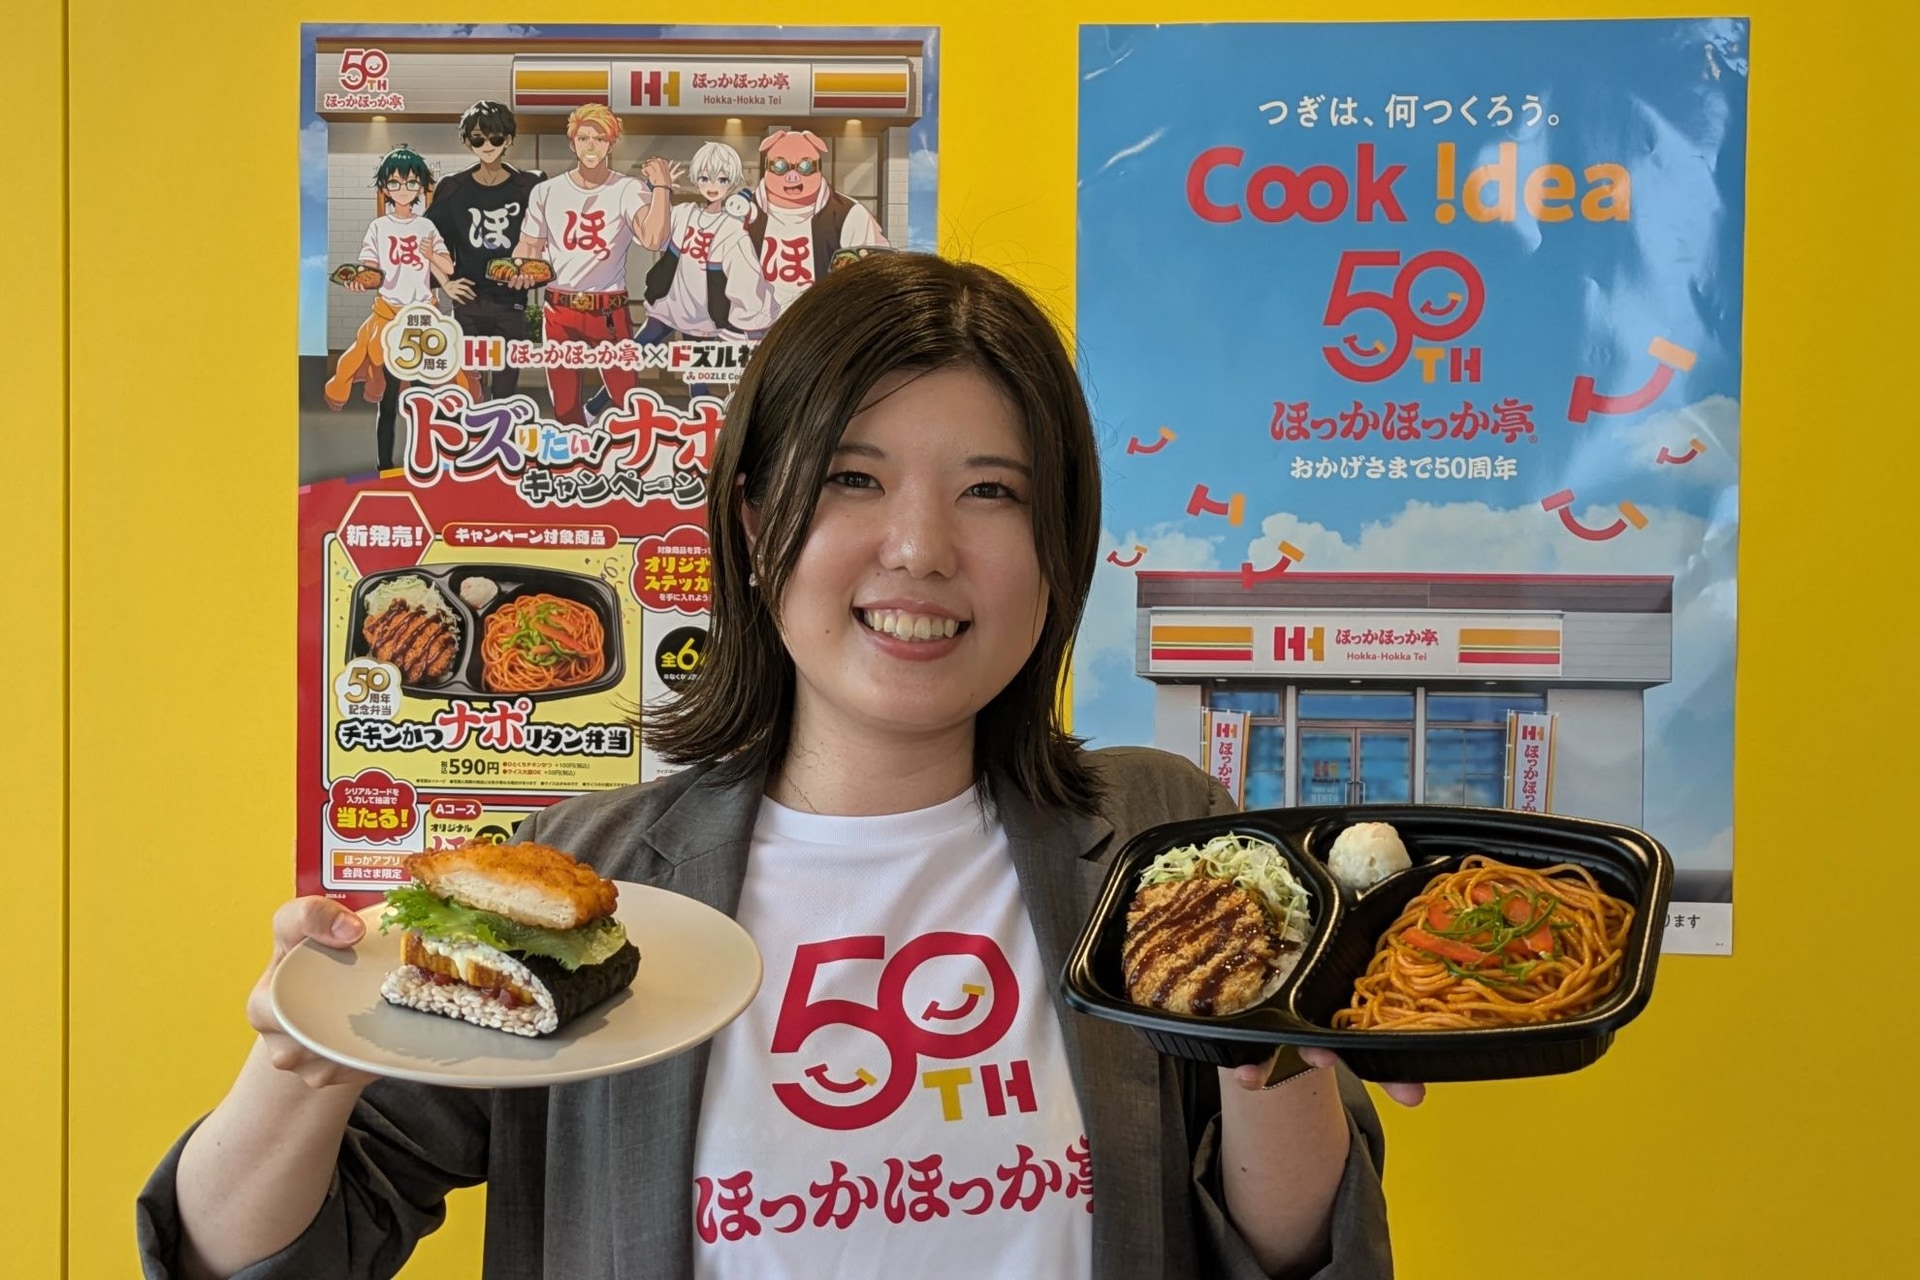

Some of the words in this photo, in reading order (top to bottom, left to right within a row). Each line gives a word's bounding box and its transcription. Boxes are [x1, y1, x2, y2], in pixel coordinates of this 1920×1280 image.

[692, 73, 790, 90] ほっかほっか亭
[325, 95, 403, 109] ほっかほっか亭
[703, 94, 766, 105] Hokka-Hokka
[768, 95, 782, 105] Tei
[1258, 94, 1560, 128] つぎは、何つくろう。
[1186, 142, 1408, 224] Cook
[407, 314, 432, 327] 創業
[394, 327, 447, 369] 50
[423, 358, 448, 371] 周年
[698, 372, 727, 380] DOZLE
[1290, 456, 1518, 480] おかげさまで50周年
[346, 524, 424, 548] 新発売!
[455, 528, 606, 546] キャンペーン対象商品
[659, 593, 712, 601] を手に入れよう
[1335, 628, 1440, 646] ほっかほっか亭
[1346, 652, 1411, 661] Hokka-Hokka
[1414, 652, 1427, 661] Tei
[345, 667, 391, 702] 50
[369, 693, 391, 704] 周年
[349, 705, 392, 716] 記念弁当
[450, 759, 499, 775] 590円
[344, 788, 399, 796] シリアルコードを
[346, 796, 397, 804] 入力して抽選で
[435, 804, 477, 815] Aコース
[337, 807, 409, 829] 当たる!
[430, 823, 472, 833] オリジナル
[344, 856, 399, 865] ほっかアプリ
[342, 868, 402, 879] 会員さま限定
